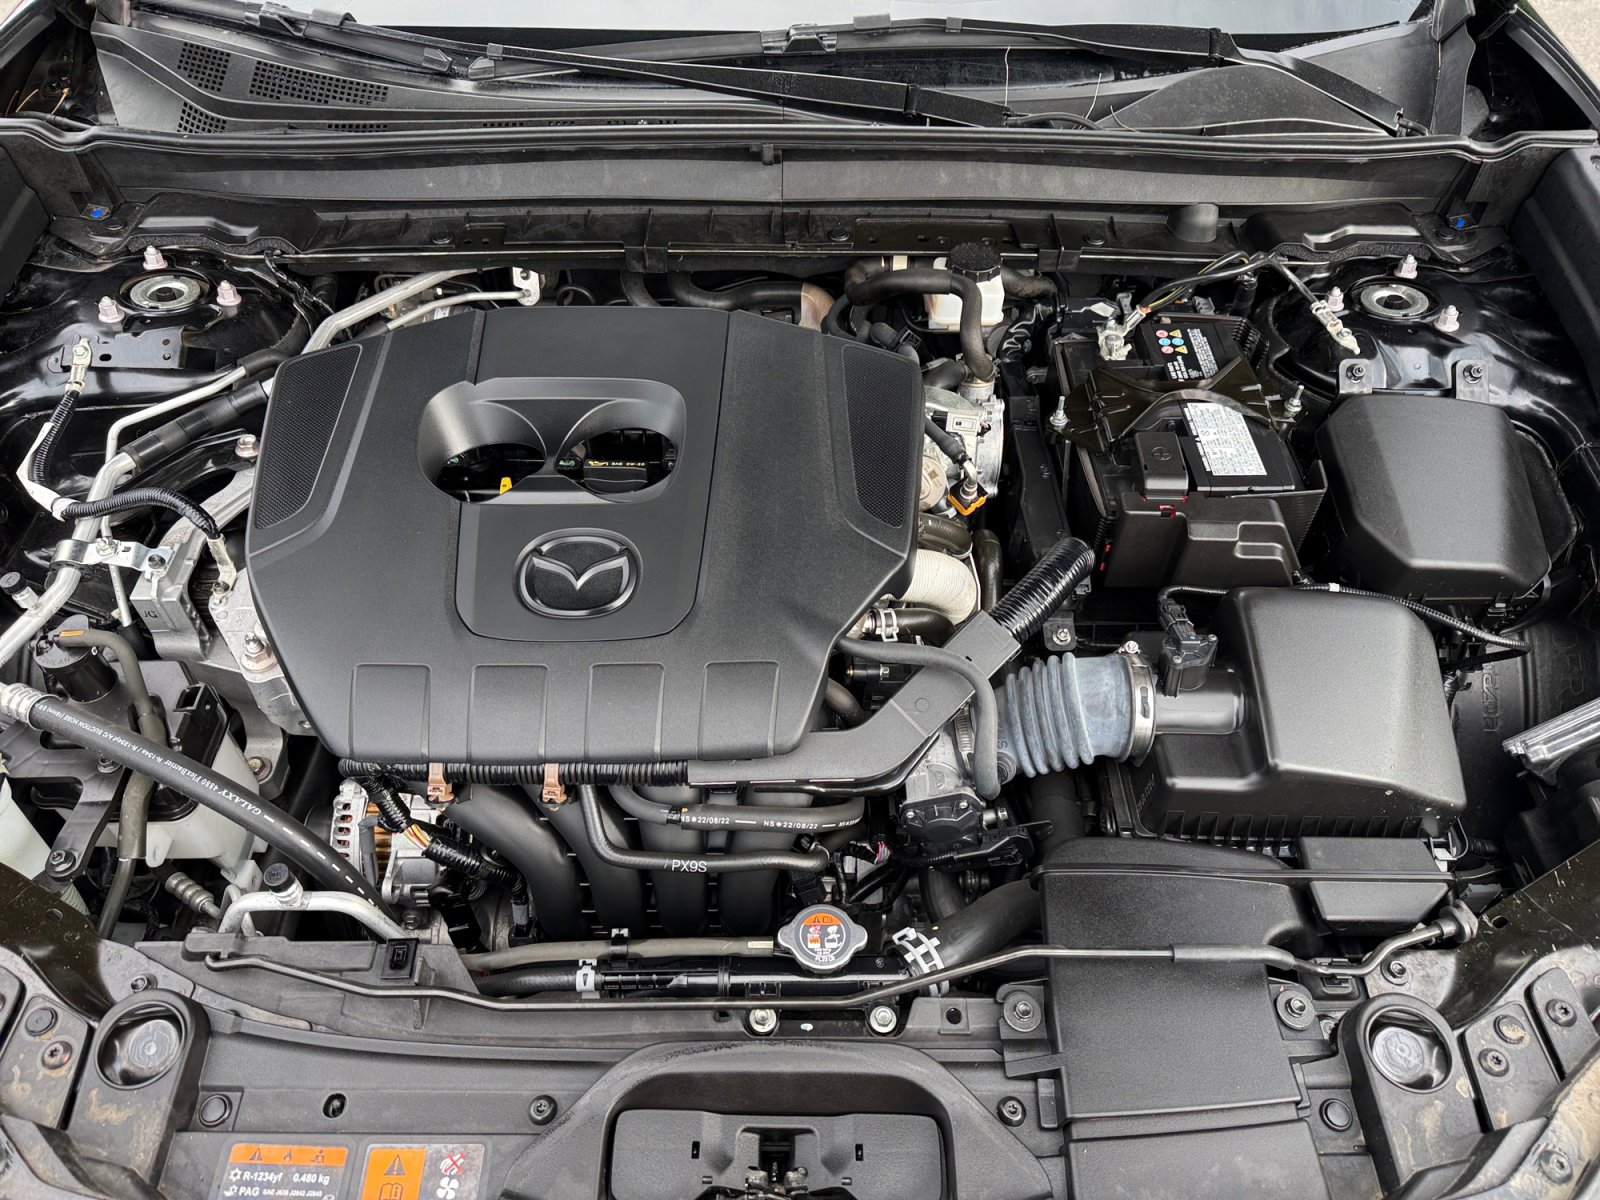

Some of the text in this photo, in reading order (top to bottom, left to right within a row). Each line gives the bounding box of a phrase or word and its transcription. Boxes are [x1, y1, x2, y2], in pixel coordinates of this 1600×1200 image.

[79, 721, 104, 736] SUCTION
[218, 788, 262, 816] GALAXY
[671, 859, 707, 873] PX9S
[242, 1171, 284, 1184] R-1234yf
[318, 1174, 330, 1186] kg
[238, 1186, 260, 1197] PAG
